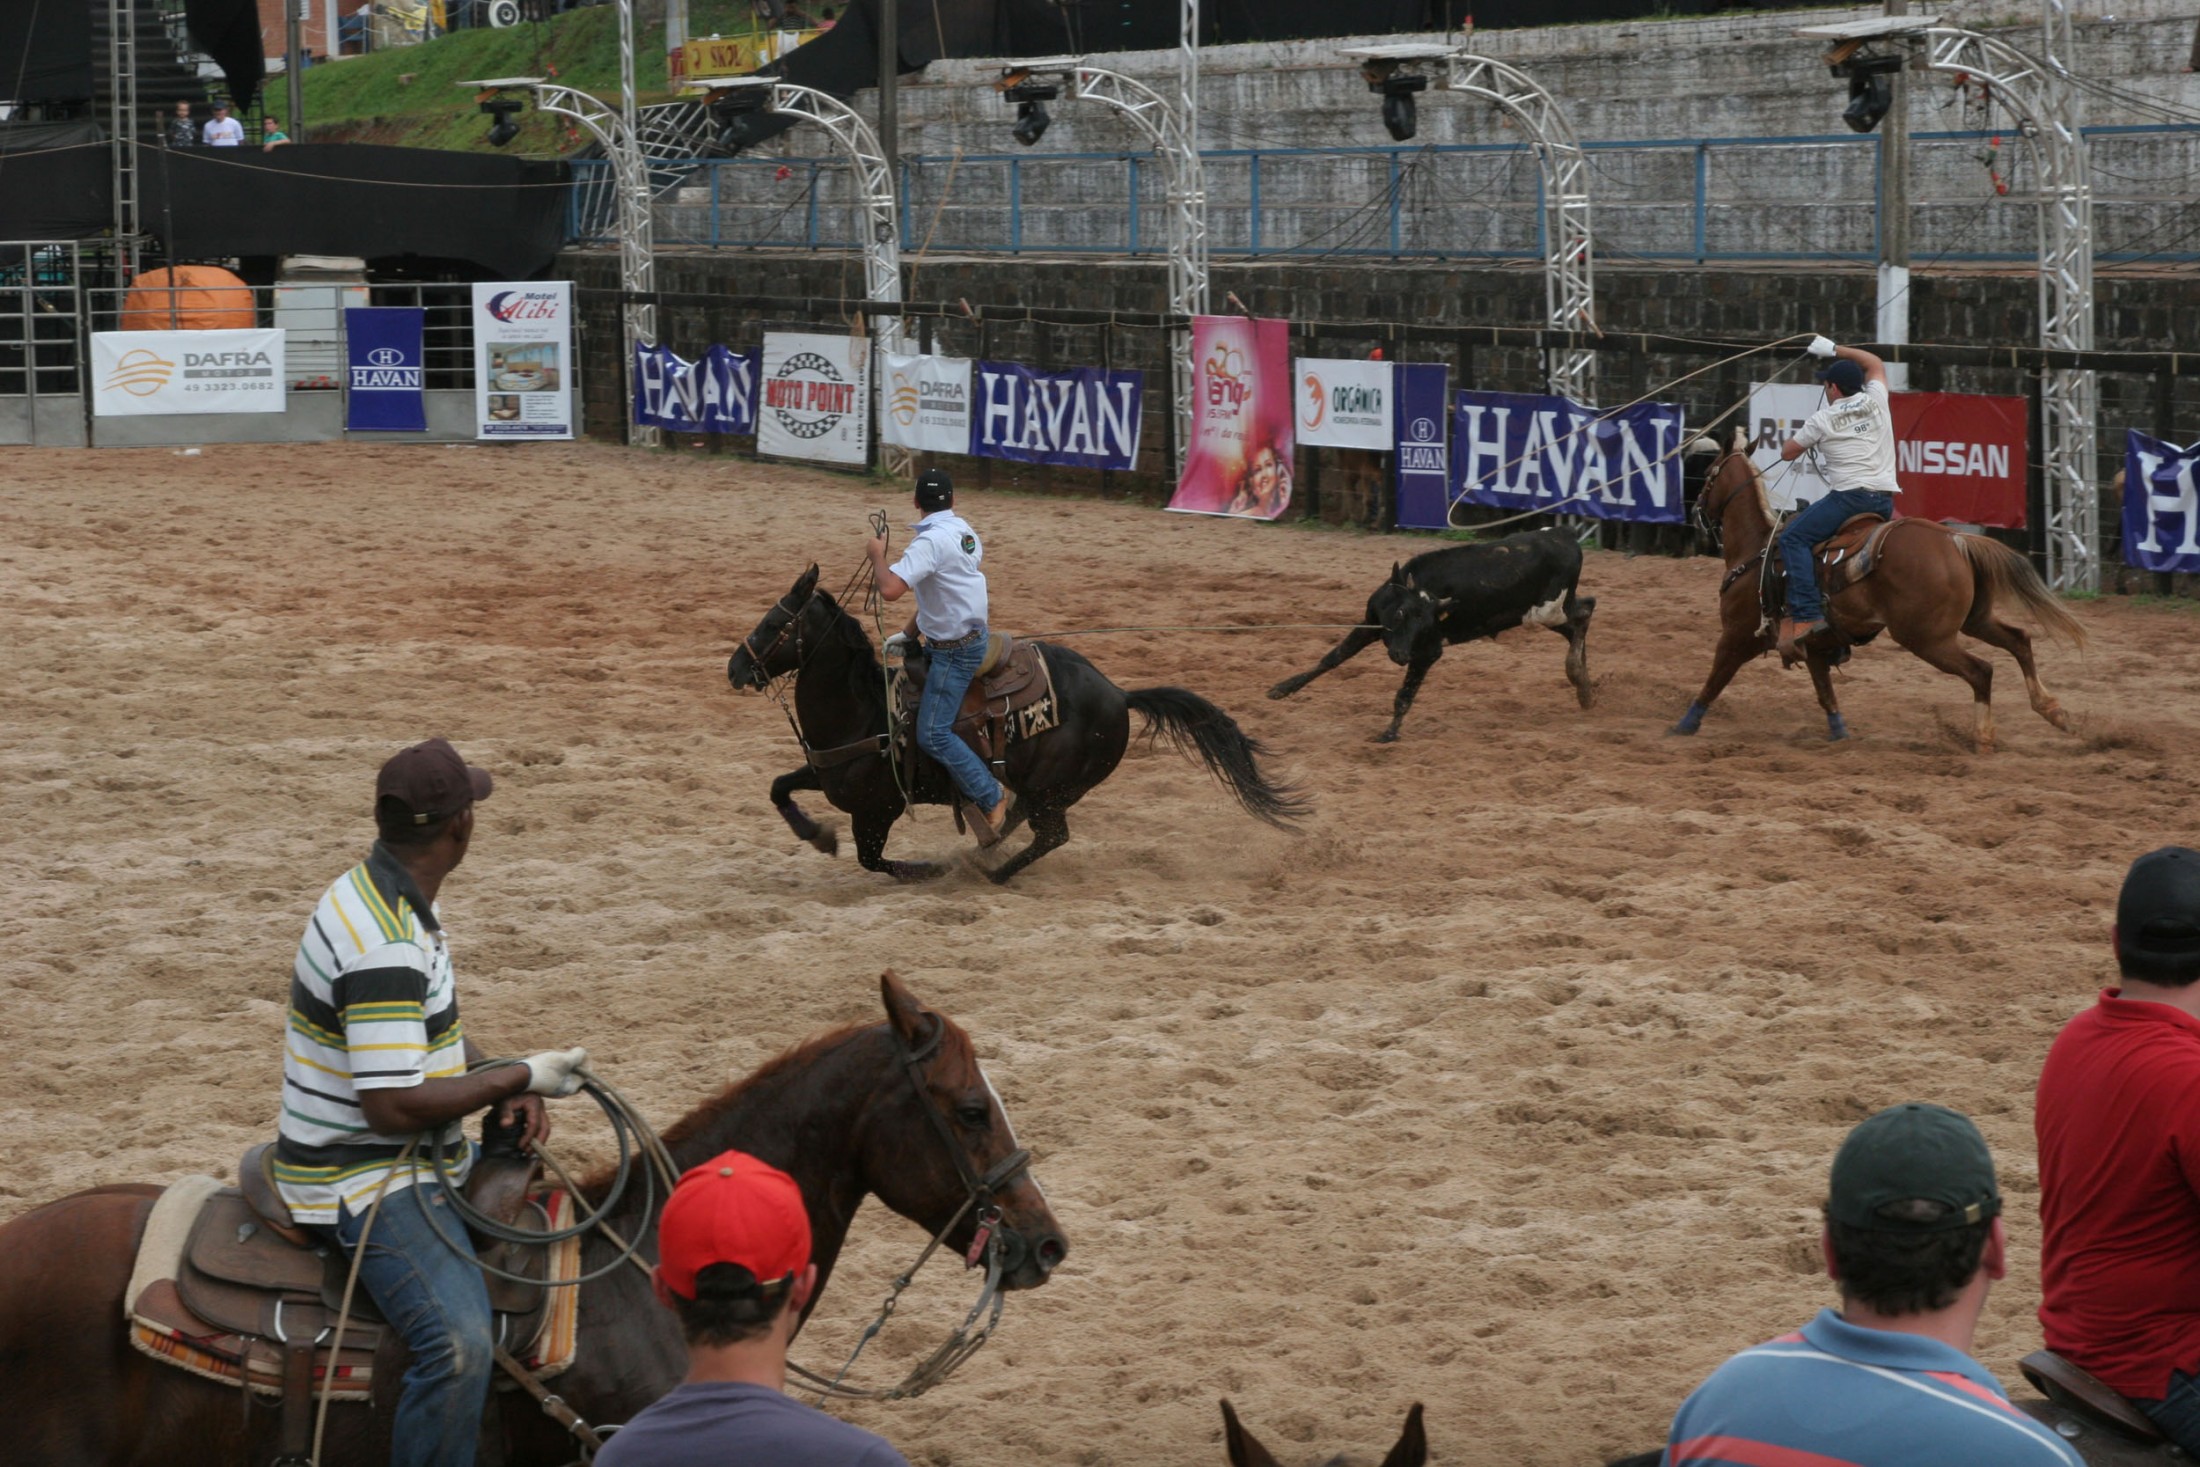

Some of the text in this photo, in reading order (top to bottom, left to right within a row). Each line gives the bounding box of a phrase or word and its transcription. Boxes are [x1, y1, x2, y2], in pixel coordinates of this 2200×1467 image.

[525, 292, 557, 300] Motel
[497, 297, 559, 319] Alibi
[184, 352, 272, 367] DAFRA
[380, 350, 393, 364] H
[184, 384, 199, 392] 49
[352, 370, 420, 387] HAVAN
[638, 351, 750, 424] HAVAN
[919, 380, 965, 399] DAFRA
[766, 378, 855, 414] MOTO POINT
[1333, 383, 1383, 415] ORGÂNICA
[982, 372, 1134, 457] HAVAN
[1418, 421, 1428, 439] H
[1400, 447, 1446, 469] HAVAN
[1463, 405, 1673, 508] HAVAN
[1899, 440, 2010, 479] NISSAN
